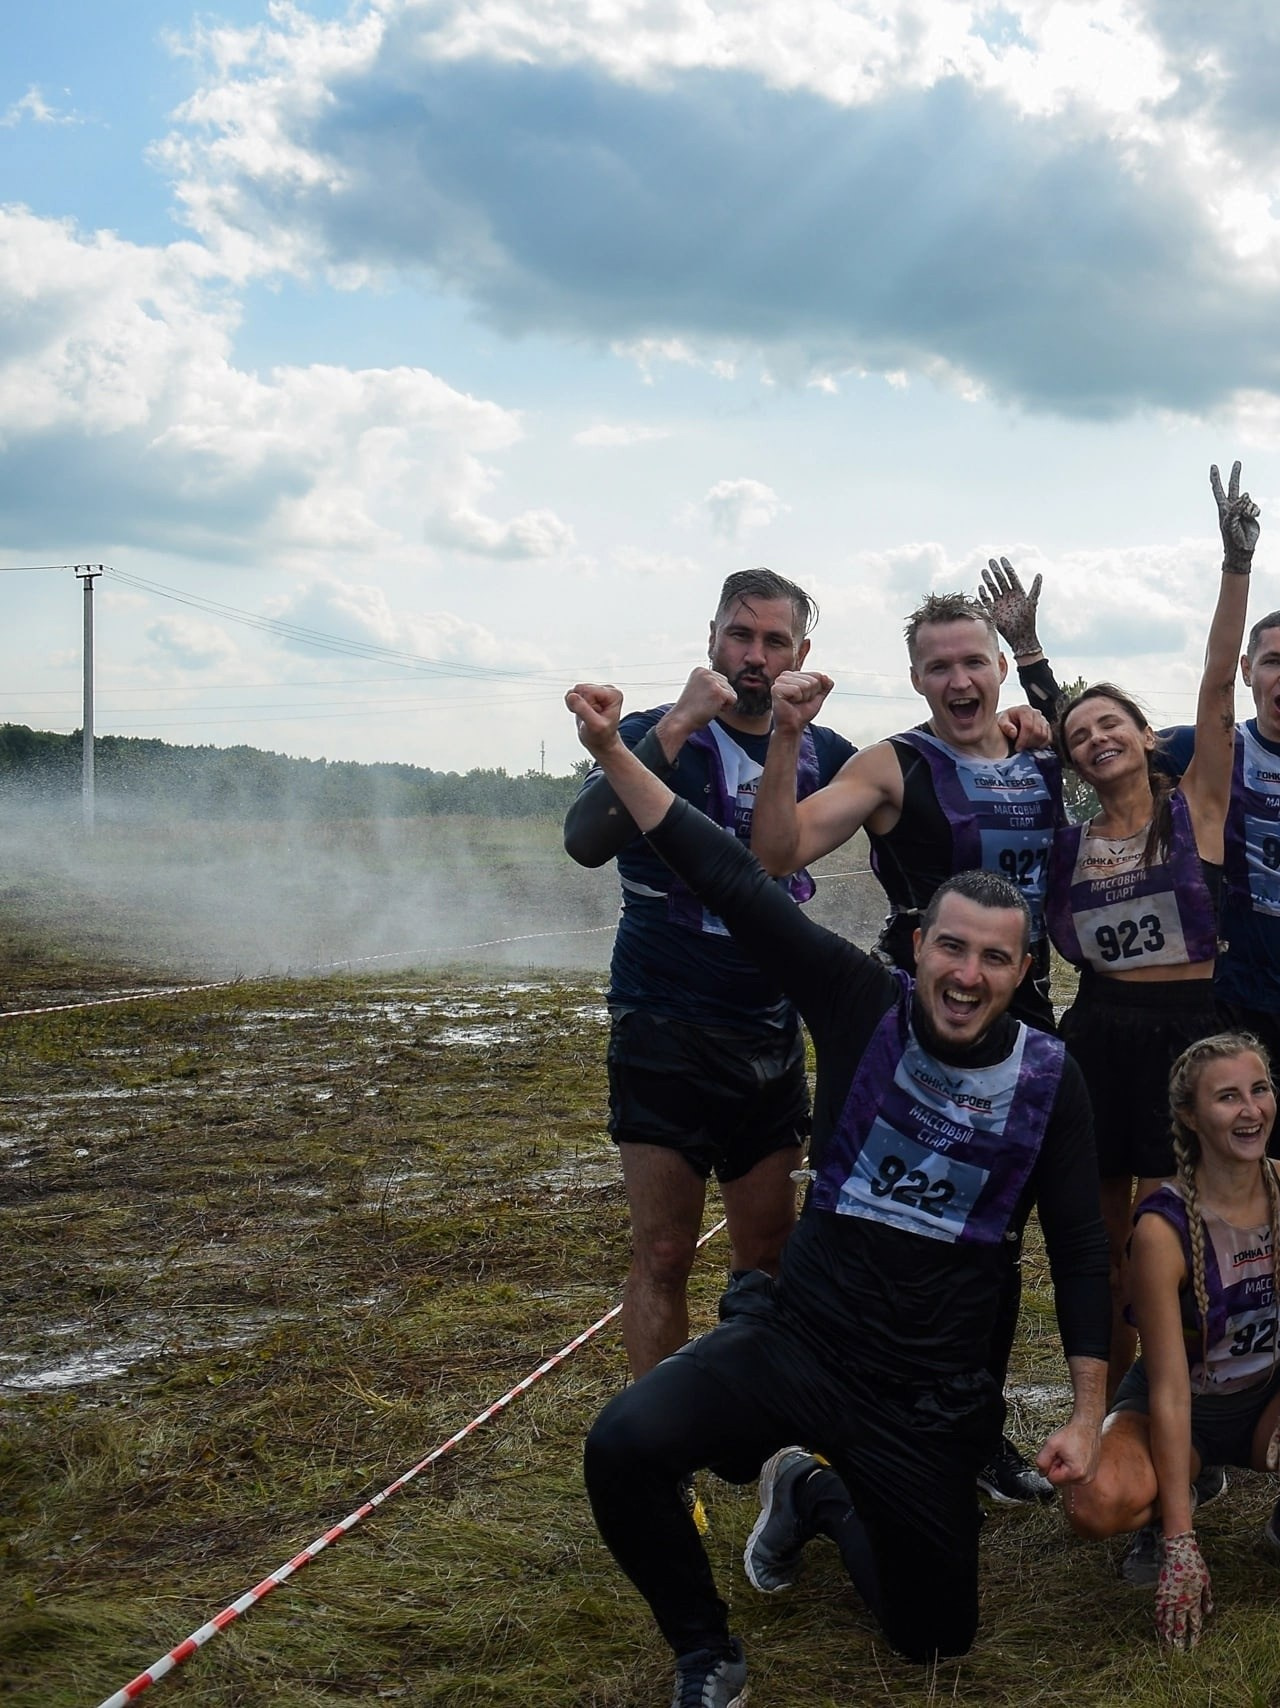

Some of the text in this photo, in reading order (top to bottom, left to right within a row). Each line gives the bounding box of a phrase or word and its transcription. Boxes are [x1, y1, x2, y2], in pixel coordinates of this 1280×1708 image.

[974, 778, 1037, 787] ГОНКА ГЕРОЕВ
[994, 801, 1042, 815] МАССОВЫЙ
[1009, 817, 1035, 828] СТАРТ
[999, 848, 1049, 886] 927
[1090, 868, 1147, 893] МАССОВЫЙ
[1105, 885, 1135, 902] СТАРТ
[1095, 914, 1166, 962] 923
[914, 1068, 950, 1096] ГОНКА
[909, 1104, 975, 1144] МАССОВЫЙ
[917, 1128, 955, 1152] СТАРТ
[870, 1154, 957, 1219] 922
[1233, 1247, 1264, 1264] ГОНКА
